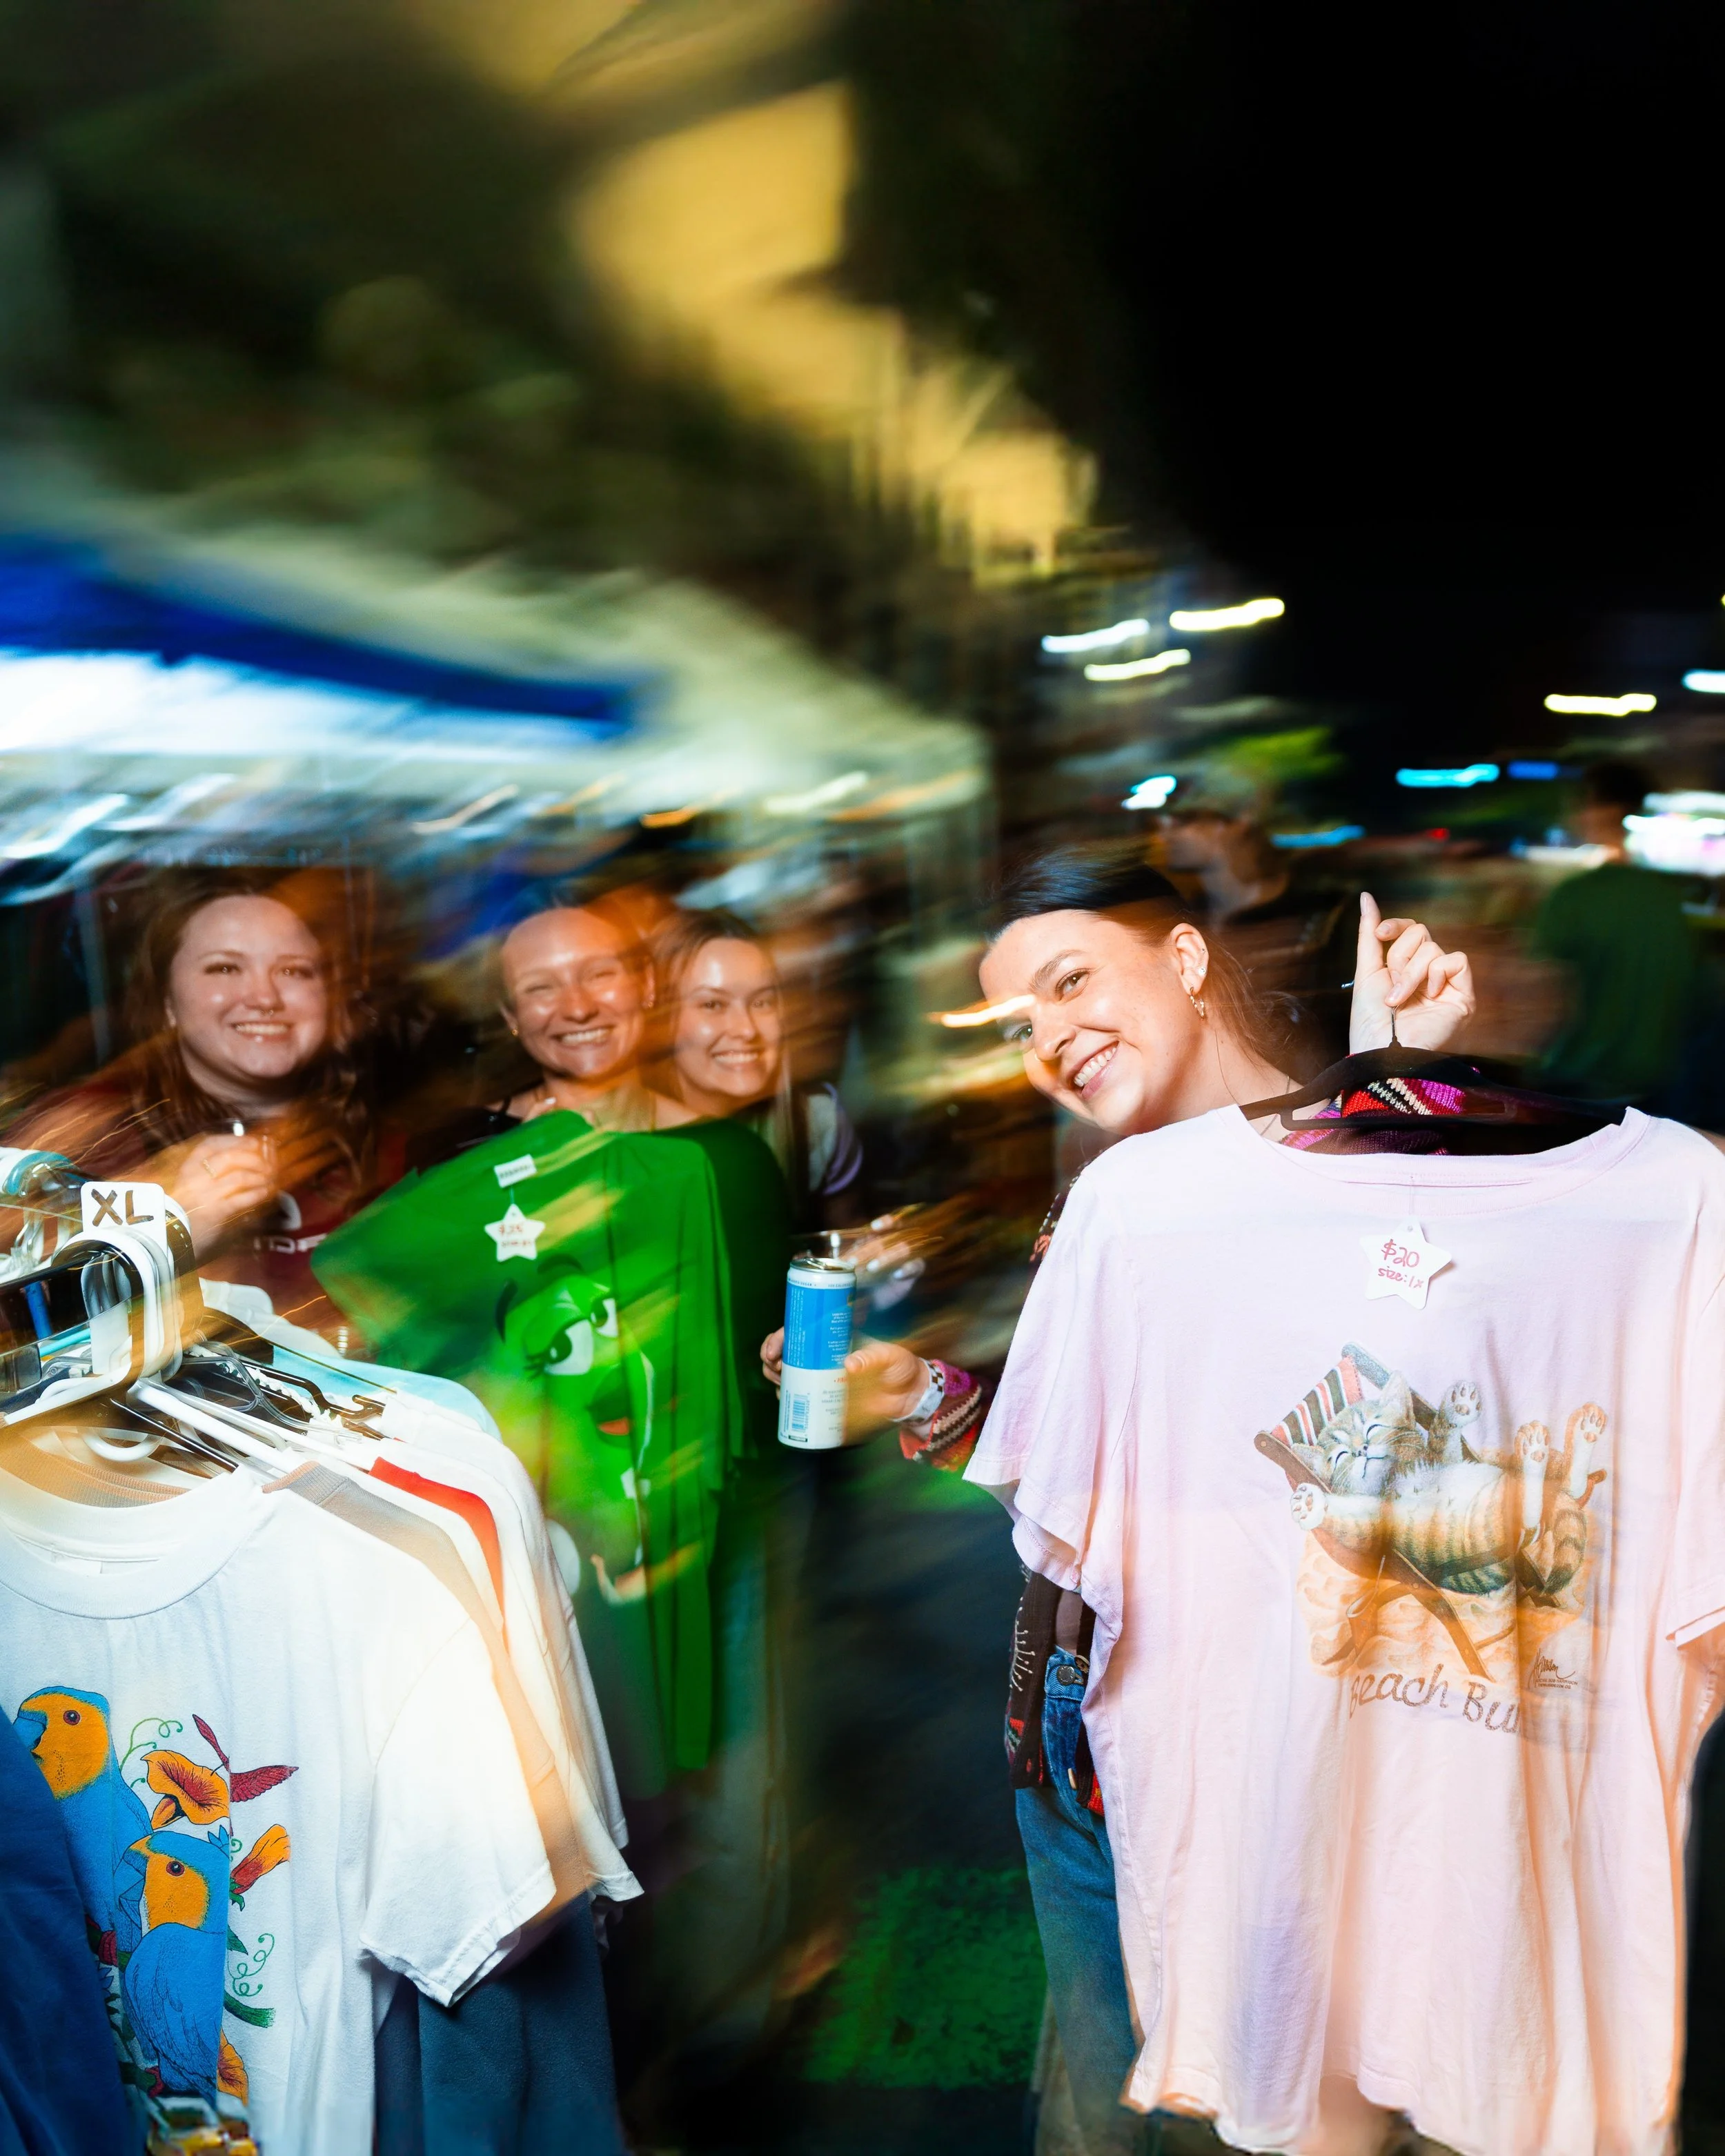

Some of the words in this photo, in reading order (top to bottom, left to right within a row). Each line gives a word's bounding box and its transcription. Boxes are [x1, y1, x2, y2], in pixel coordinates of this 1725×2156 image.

[90, 1188, 155, 1227] XL
[1381, 1238, 1420, 1268] $20
[1462, 1681, 1521, 1734] Bu
